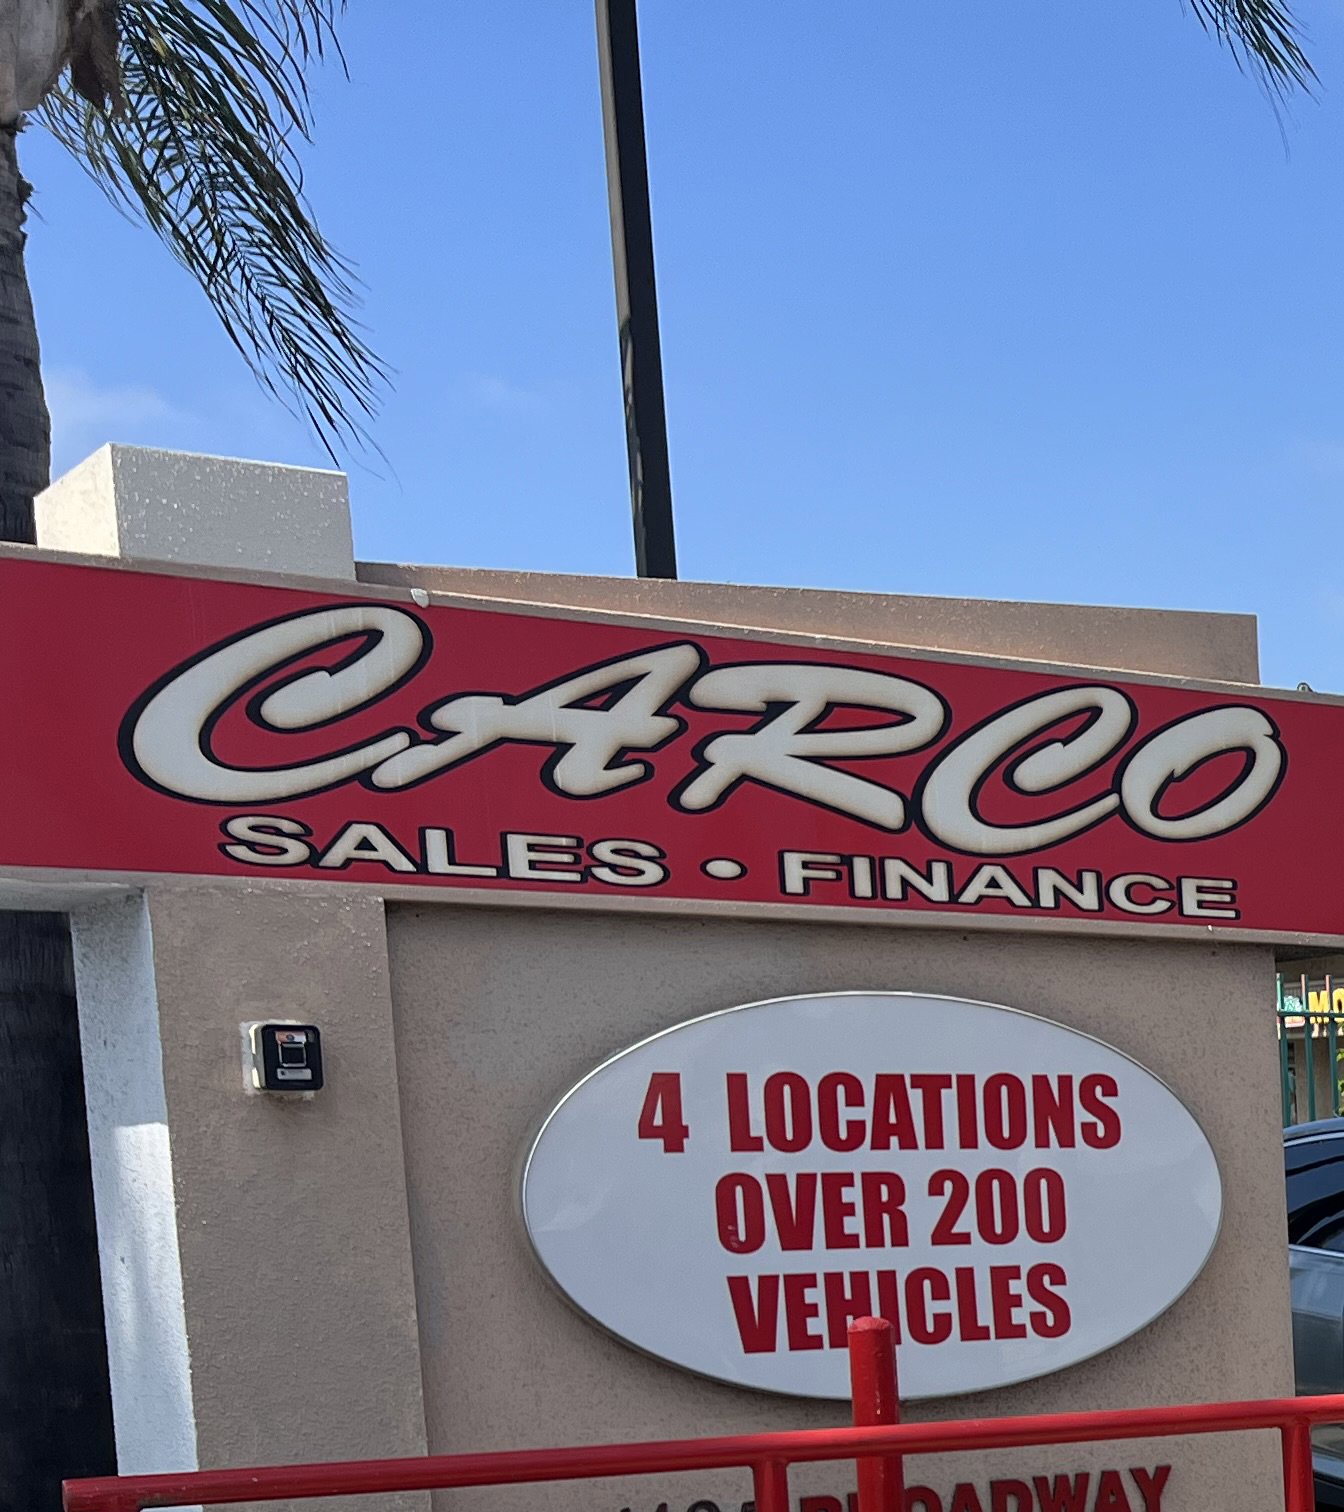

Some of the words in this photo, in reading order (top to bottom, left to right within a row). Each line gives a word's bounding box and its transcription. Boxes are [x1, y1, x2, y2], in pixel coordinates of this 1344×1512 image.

[119, 600, 1289, 858] CARCO
[219, 811, 672, 887] SALES
[778, 849, 1242, 921] FINANCE
[637, 1072, 689, 1153] 4
[726, 1071, 1121, 1153] LOCATIONS
[714, 1171, 909, 1254] OVER
[927, 1167, 1067, 1247] 200
[726, 1262, 1072, 1355] VEHICLES
